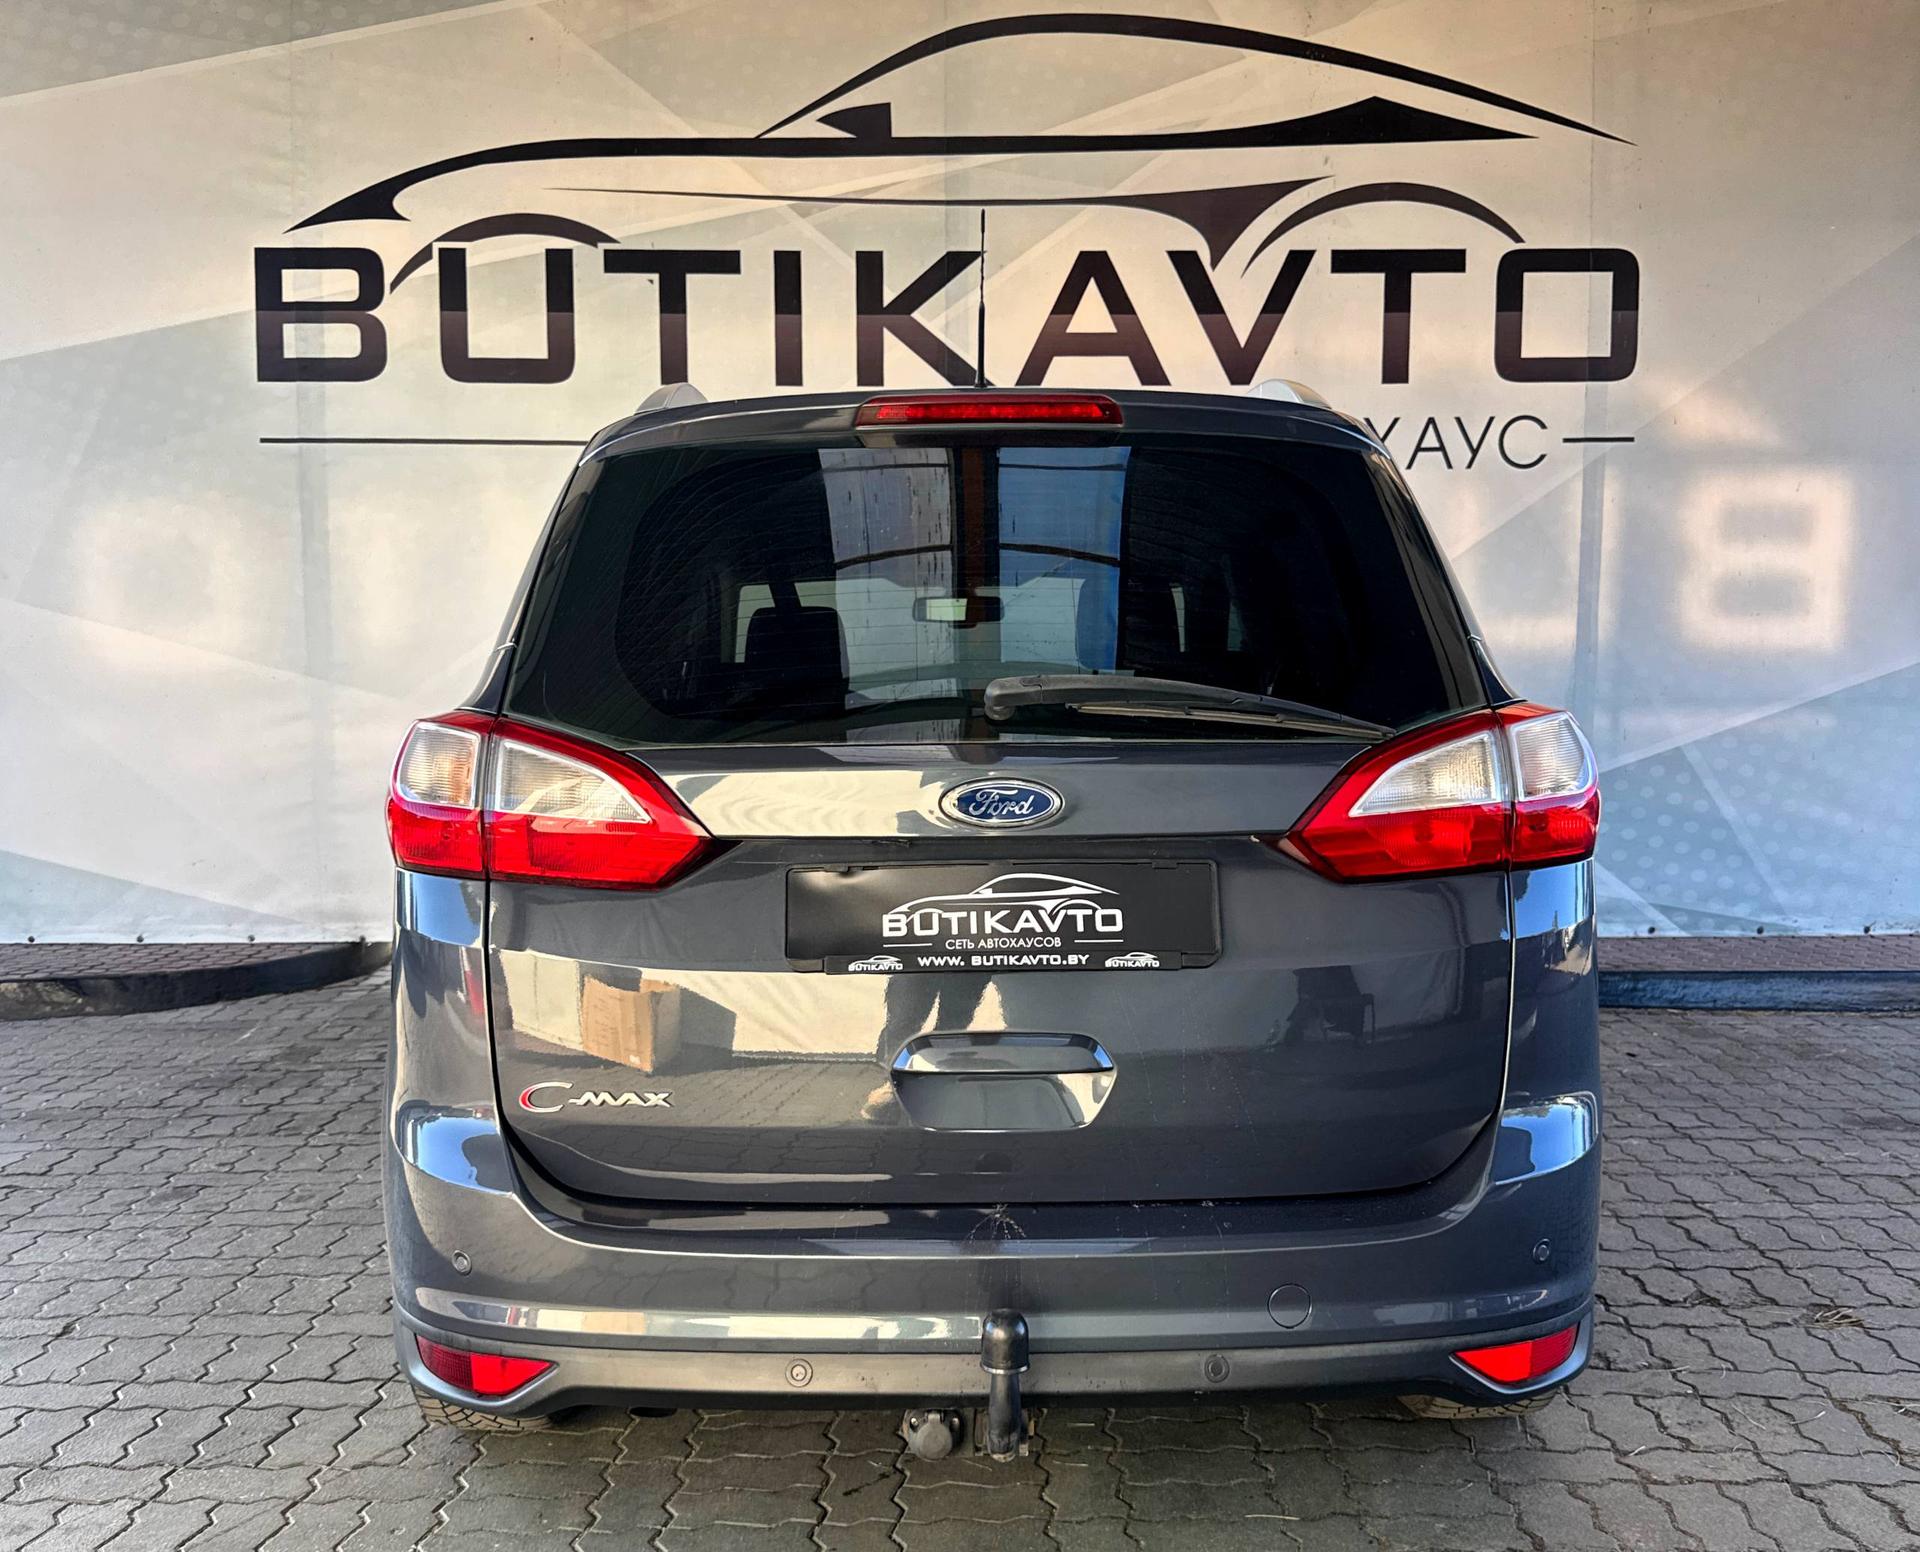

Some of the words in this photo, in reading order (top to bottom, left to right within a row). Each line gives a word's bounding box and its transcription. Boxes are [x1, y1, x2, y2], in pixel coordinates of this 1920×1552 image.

[254, 247, 1640, 386] BUTIKAVTO
[968, 788, 1035, 816] Ford
[881, 908, 1124, 938] BUTIKAVTO
[945, 938, 975, 950] СЕТЬ
[977, 936, 1062, 949] АВТОХАУСОВ
